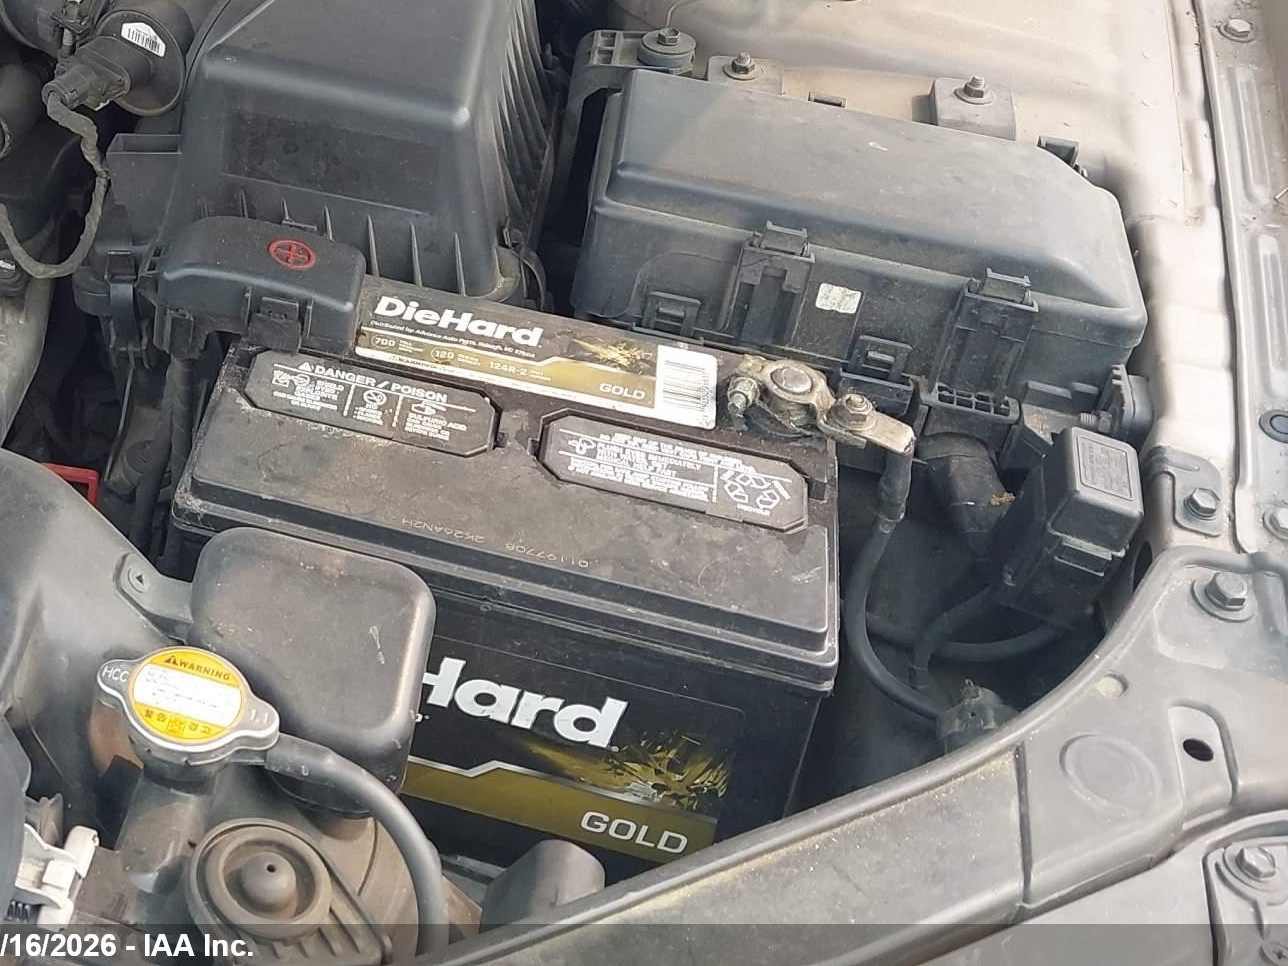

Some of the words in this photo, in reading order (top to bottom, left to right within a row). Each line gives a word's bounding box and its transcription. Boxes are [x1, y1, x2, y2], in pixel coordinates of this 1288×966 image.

[373, 294, 544, 348] DieHard
[375, 336, 396, 348] 700
[435, 349, 455, 359] 120
[489, 361, 529, 377] 124R-2
[314, 364, 378, 387] DANGER
[377, 379, 391, 390] /
[390, 380, 449, 404] POISON
[598, 382, 648, 402] GOLD
[102, 665, 130, 683] HCC
[177, 658, 231, 682] WARNING
[249, 709, 270, 724] 1.1
[580, 810, 689, 854] GOLD
